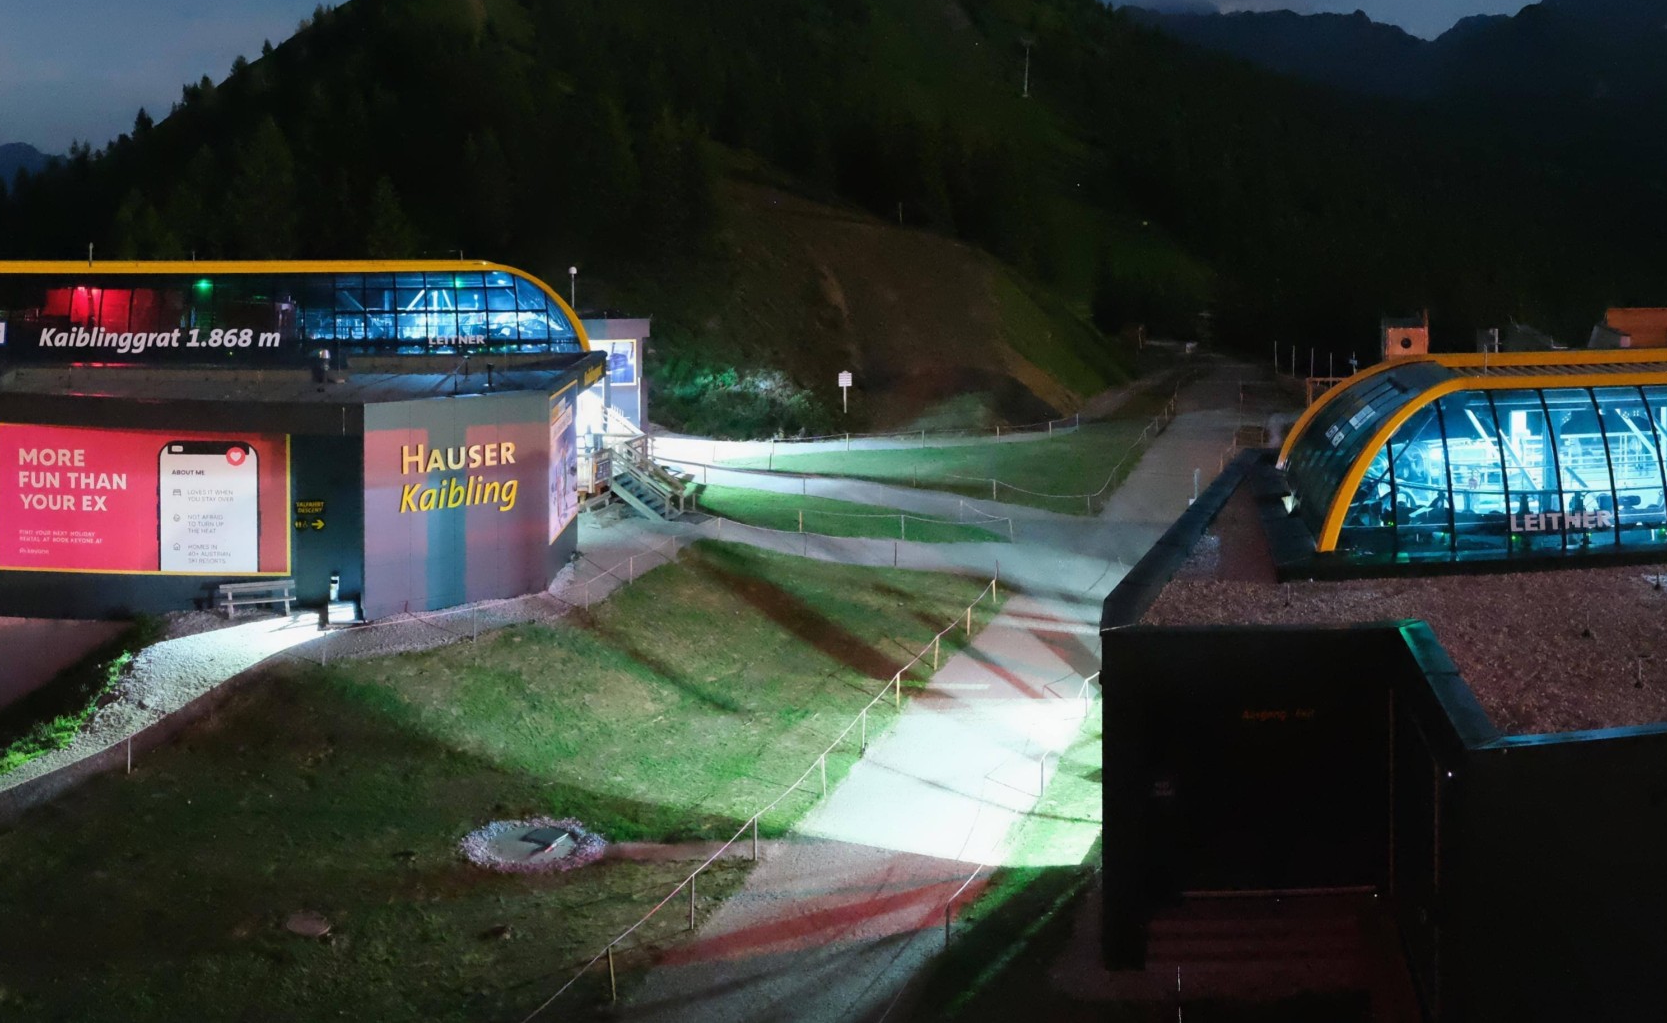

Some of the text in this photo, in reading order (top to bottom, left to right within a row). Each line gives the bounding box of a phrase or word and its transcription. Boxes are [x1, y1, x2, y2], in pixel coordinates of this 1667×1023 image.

[39, 326, 280, 354] Kaiblinggrat 1.868 m
[428, 335, 485, 346] LEITNER
[18, 448, 85, 467] MORE
[401, 441, 516, 475] HAUSER
[18, 471, 127, 490] FUN THAN
[20, 493, 108, 512] YOUR EX
[399, 476, 518, 514] Kaibling
